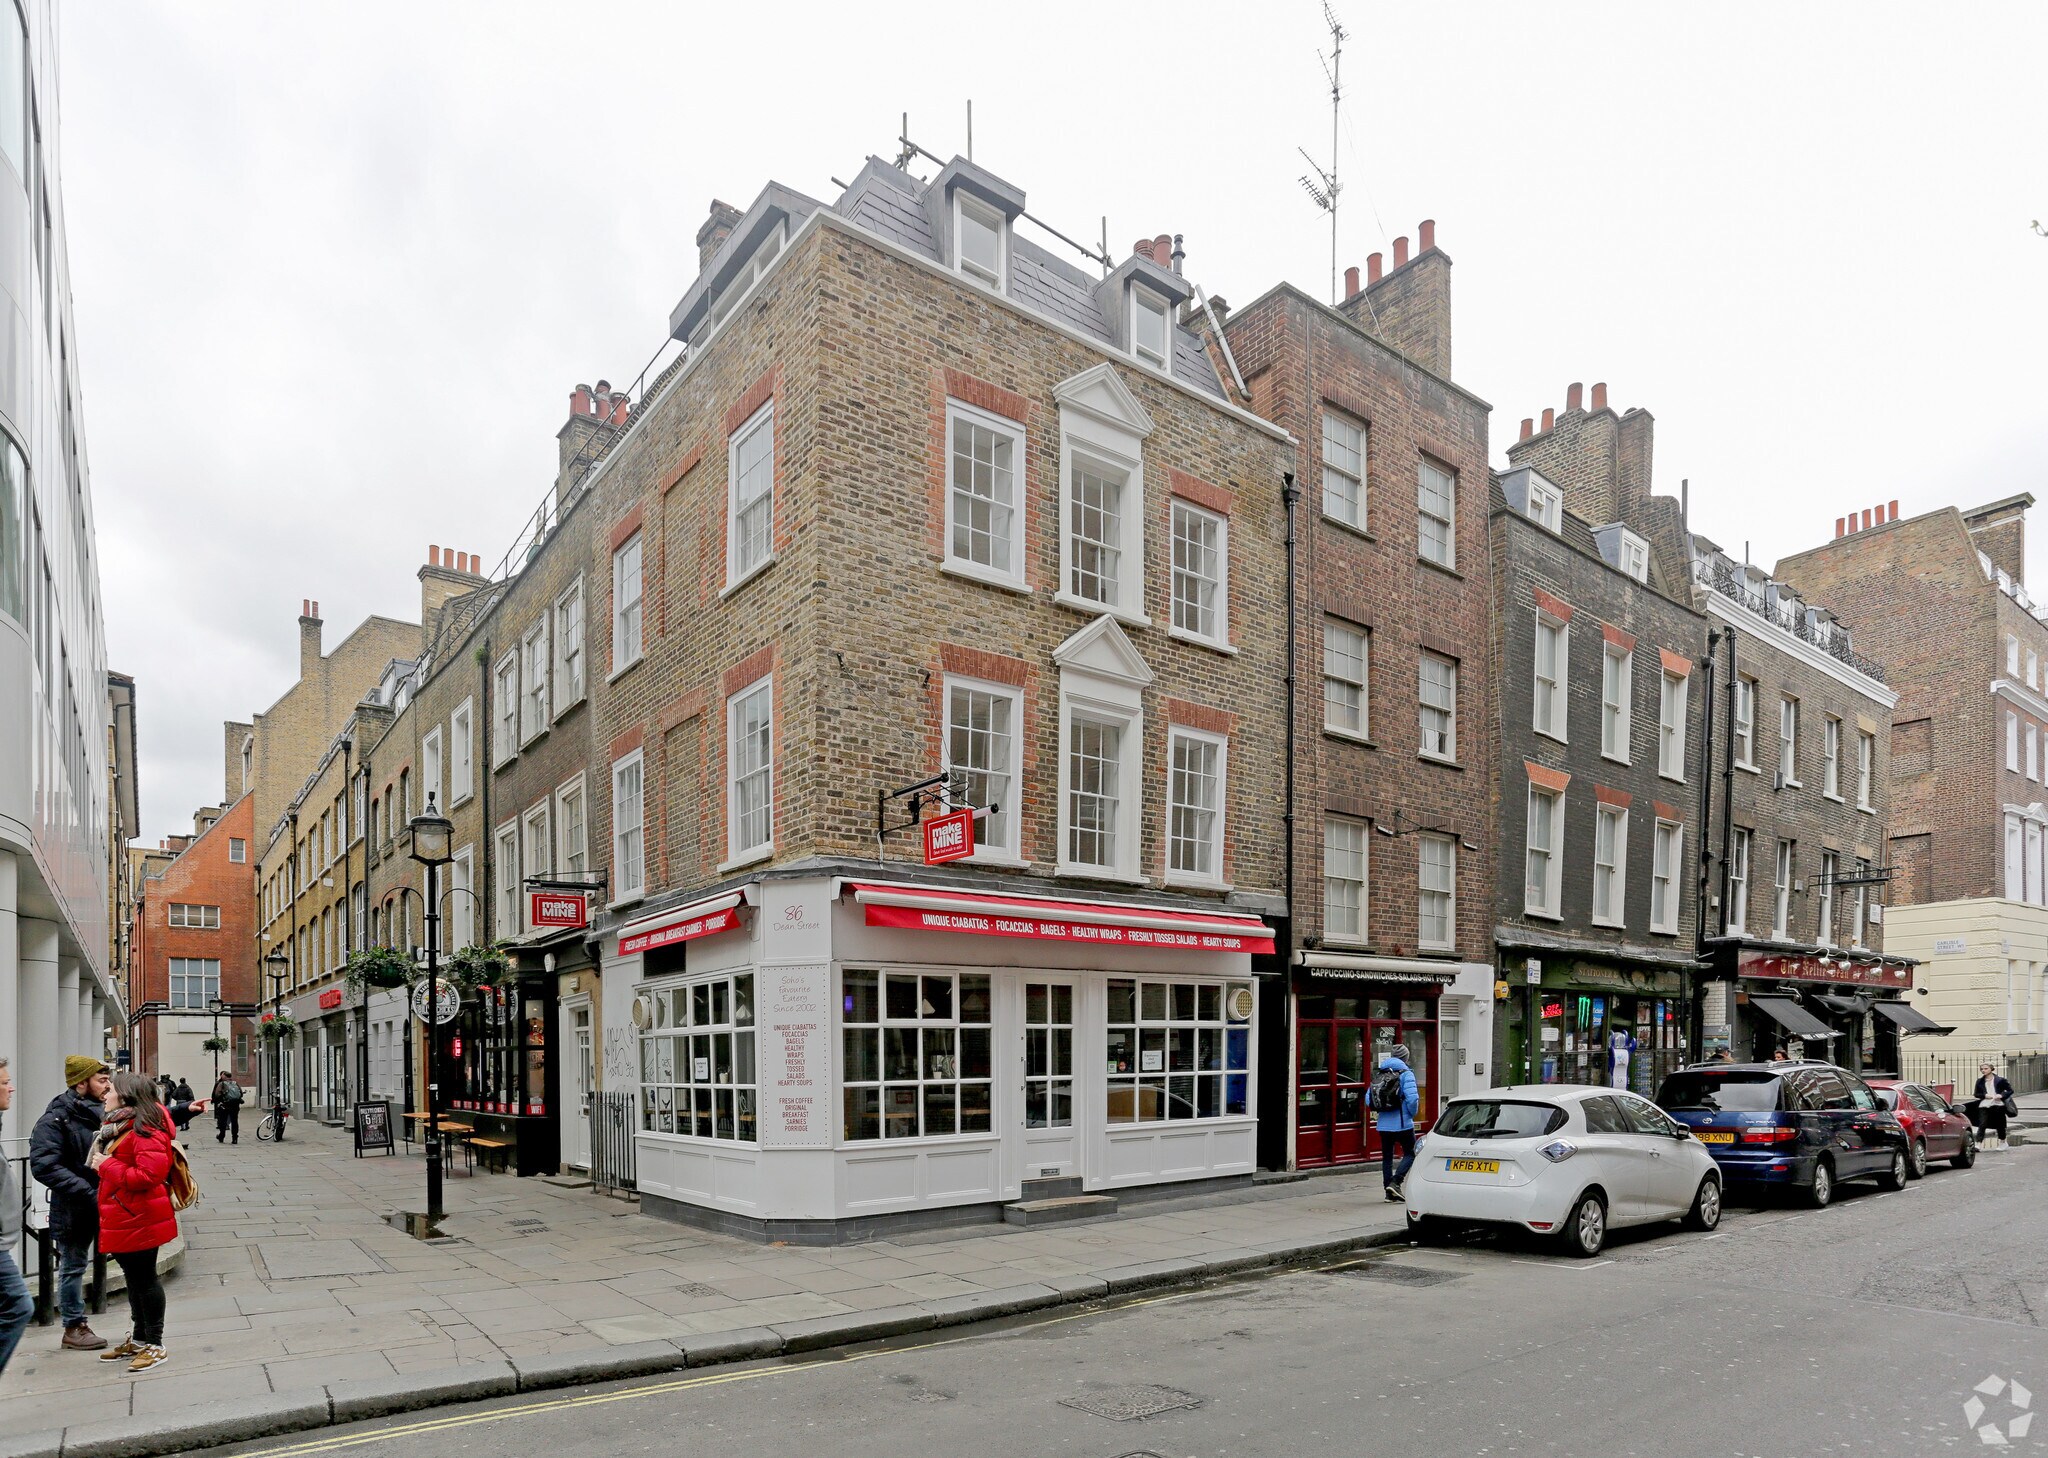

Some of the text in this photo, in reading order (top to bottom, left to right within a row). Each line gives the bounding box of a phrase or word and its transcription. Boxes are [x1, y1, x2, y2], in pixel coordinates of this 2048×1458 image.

[932, 822, 962, 837] make
[933, 831, 963, 850] MINE
[542, 901, 576, 910] make
[542, 908, 576, 918] MINE
[784, 905, 803, 921] 86
[706, 914, 726, 930] PORRIDGE
[773, 920, 820, 931] Dean Street
[922, 913, 1241, 949] UNIQUE CIABATTAS FOCACCIAS BAGELS HEALTHY WRAPS FRESHLY TOSSED SALADS HEARTY SOUPS
[782, 976, 805, 985] Soho's
[779, 986, 811, 994] Favourite
[782, 995, 808, 1003] Eatery
[773, 1004, 817, 1013] Since 2002
[1711, 1133, 1732, 1141] XNU
[1452, 1160, 1494, 1171] KF16 XTL
